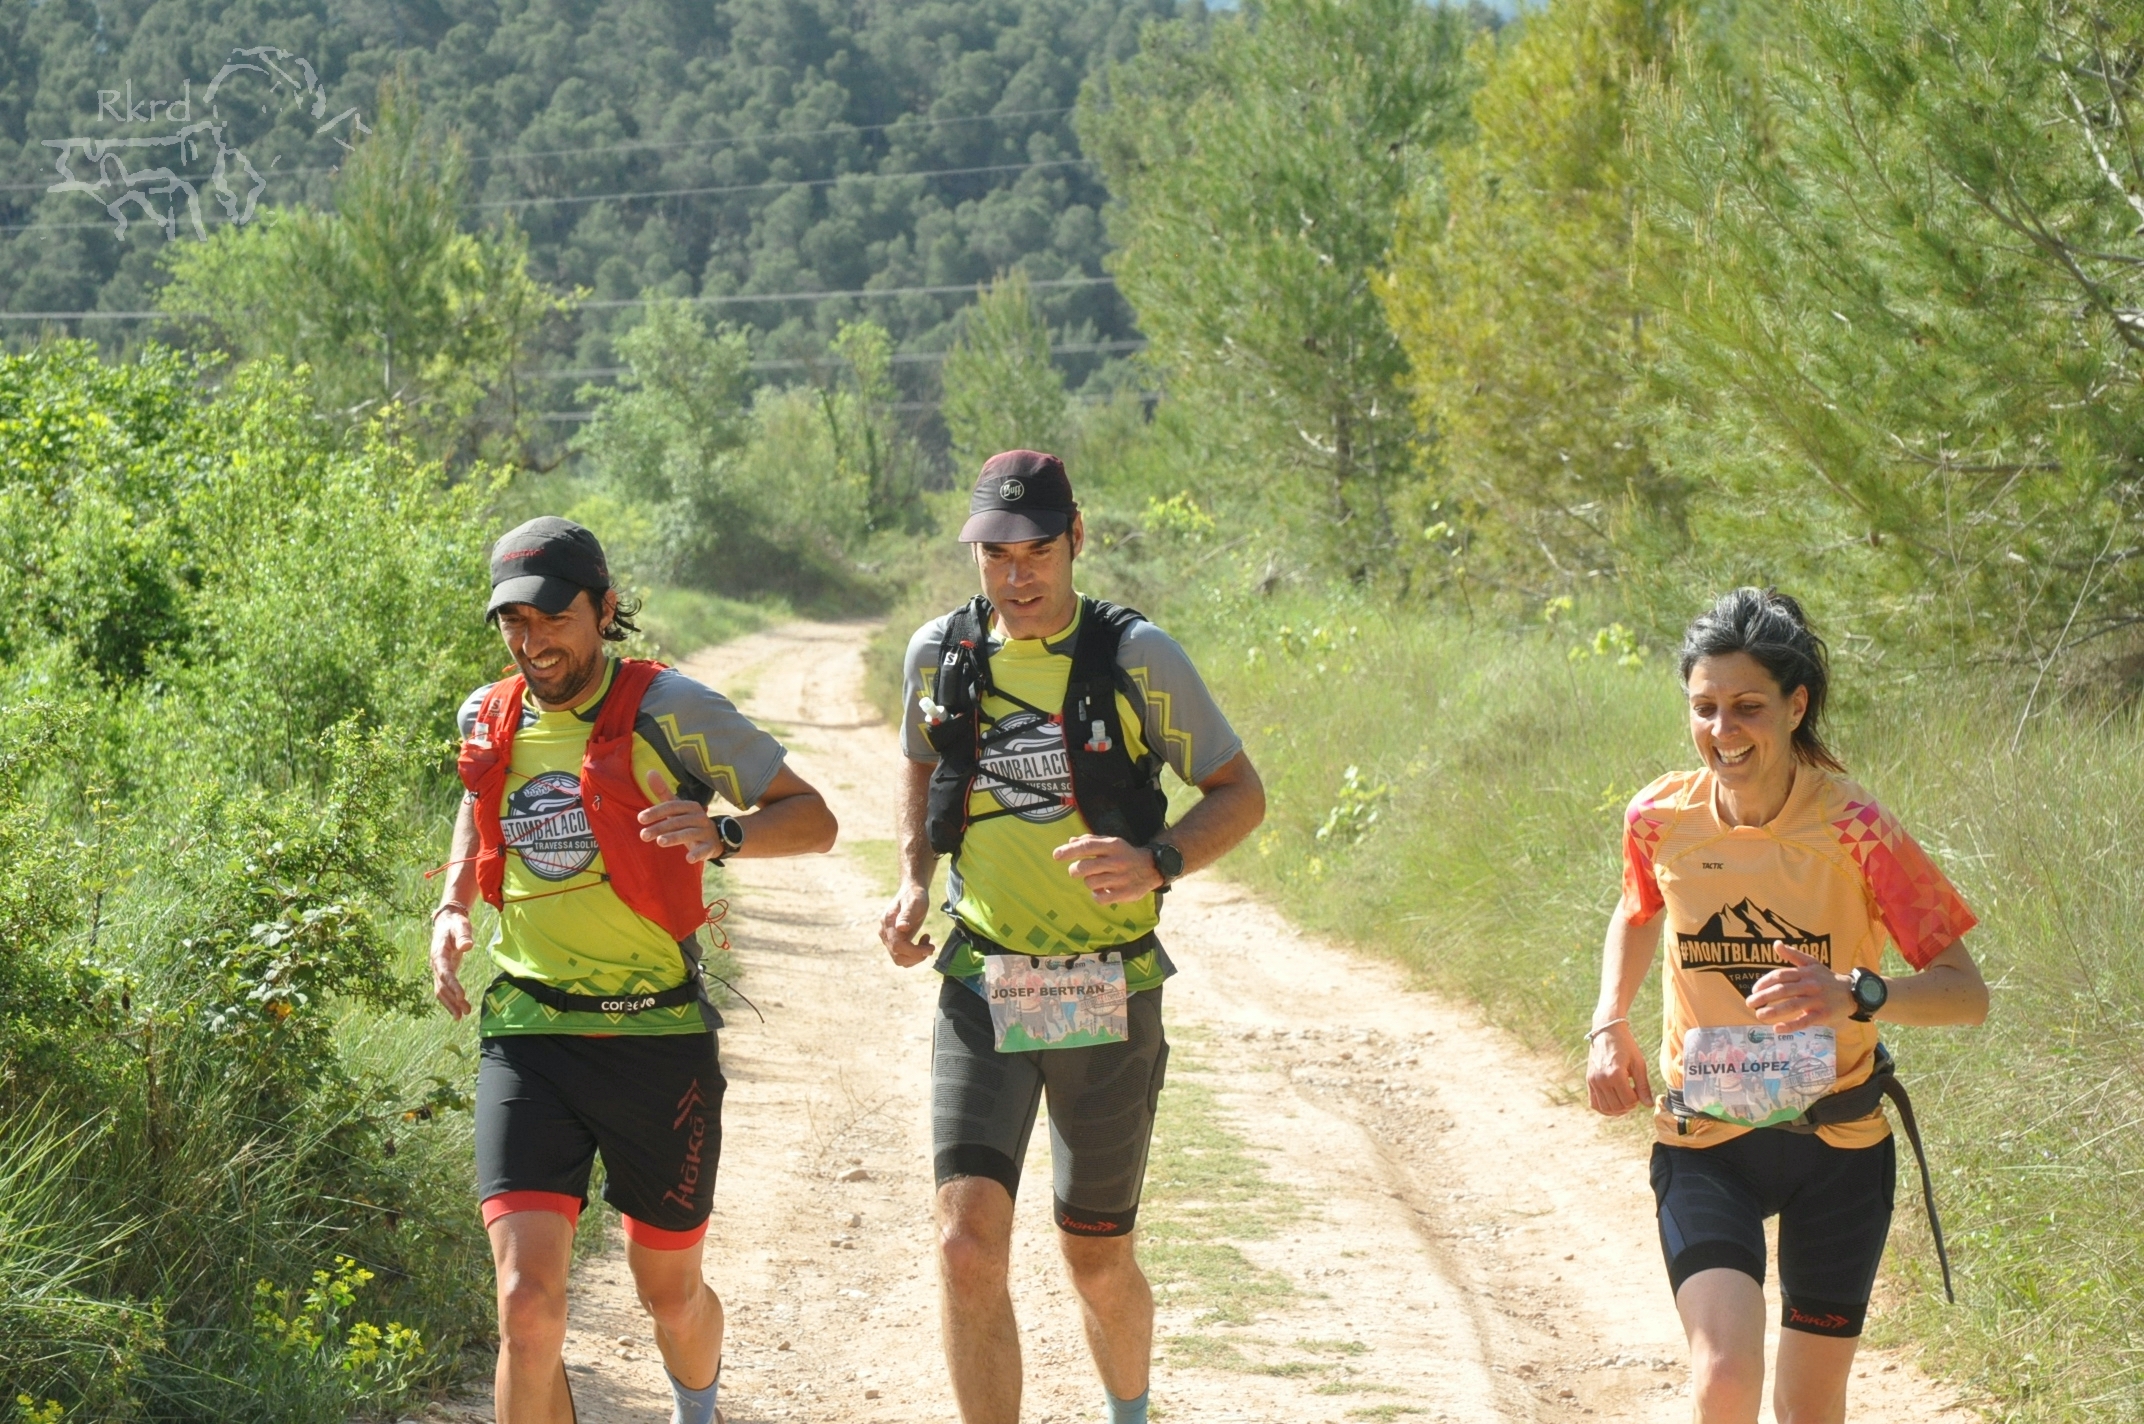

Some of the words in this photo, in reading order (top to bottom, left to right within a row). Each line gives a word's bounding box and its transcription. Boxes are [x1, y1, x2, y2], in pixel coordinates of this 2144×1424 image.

[503, 810, 591, 842] #TOMBALACO
[535, 841, 573, 850] TRAVESSA
[1702, 862, 1724, 870] TACTIC
[1729, 972, 1765, 981] TRAVE
[991, 988, 1035, 999] JOSEP
[1040, 985, 1105, 996] BERTRAN
[1741, 1060, 1790, 1073] LÓPEZ
